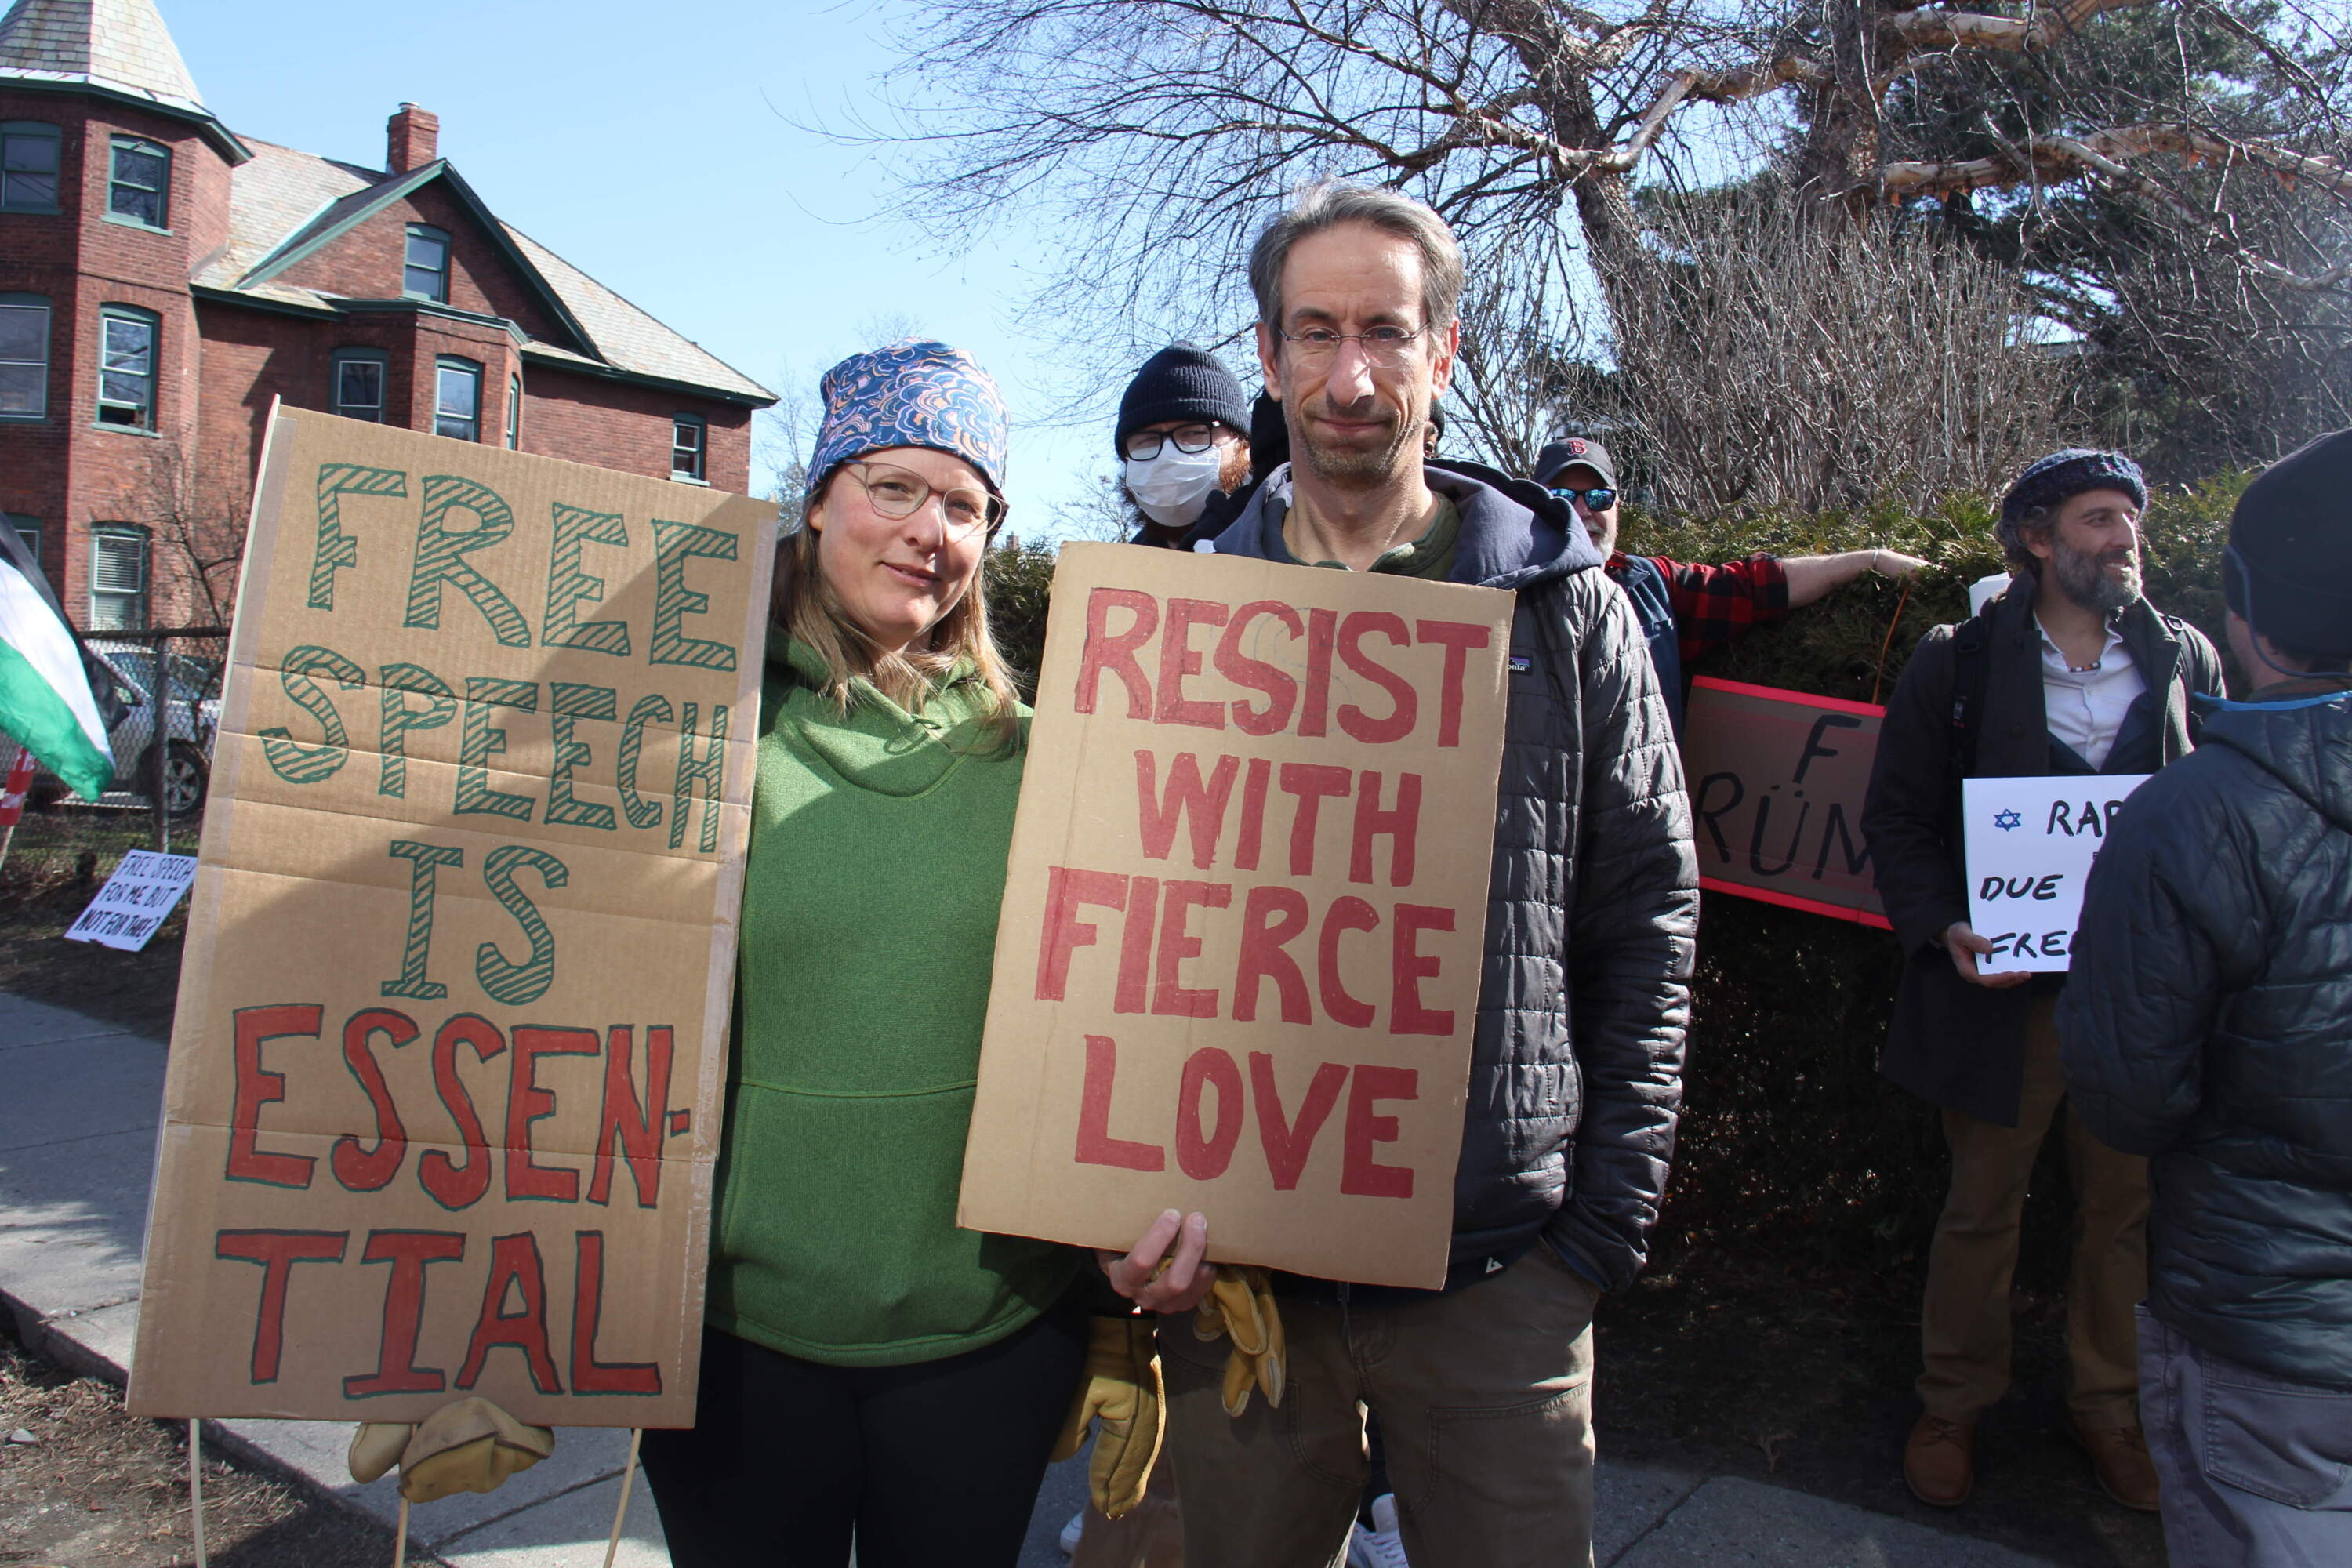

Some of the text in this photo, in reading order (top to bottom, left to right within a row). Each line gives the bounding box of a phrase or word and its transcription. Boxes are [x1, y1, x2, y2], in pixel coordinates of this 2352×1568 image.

[1566, 440, 1587, 456] B
[308, 463, 739, 672] FREE
[1074, 587, 1491, 747] RESIST
[259, 645, 728, 853] SPEECH
[1134, 749, 1422, 886] WITH
[1792, 714, 1861, 784] F
[117, 855, 196, 883] FREE SPEECH
[1693, 772, 1870, 880] RÜM
[1980, 874, 2063, 902] DUE
[74, 909, 113, 931] NOT
[100, 913, 130, 935] FOR
[100, 882, 178, 908] FOR ME BUT
[381, 840, 569, 1006] IS
[1035, 865, 1456, 1035] FIERCE
[1984, 930, 2077, 964] FRE
[225, 1004, 691, 1211] ESSEN-
[1075, 1035, 1418, 1198] LOVE
[216, 1229, 662, 1400] TIAL
